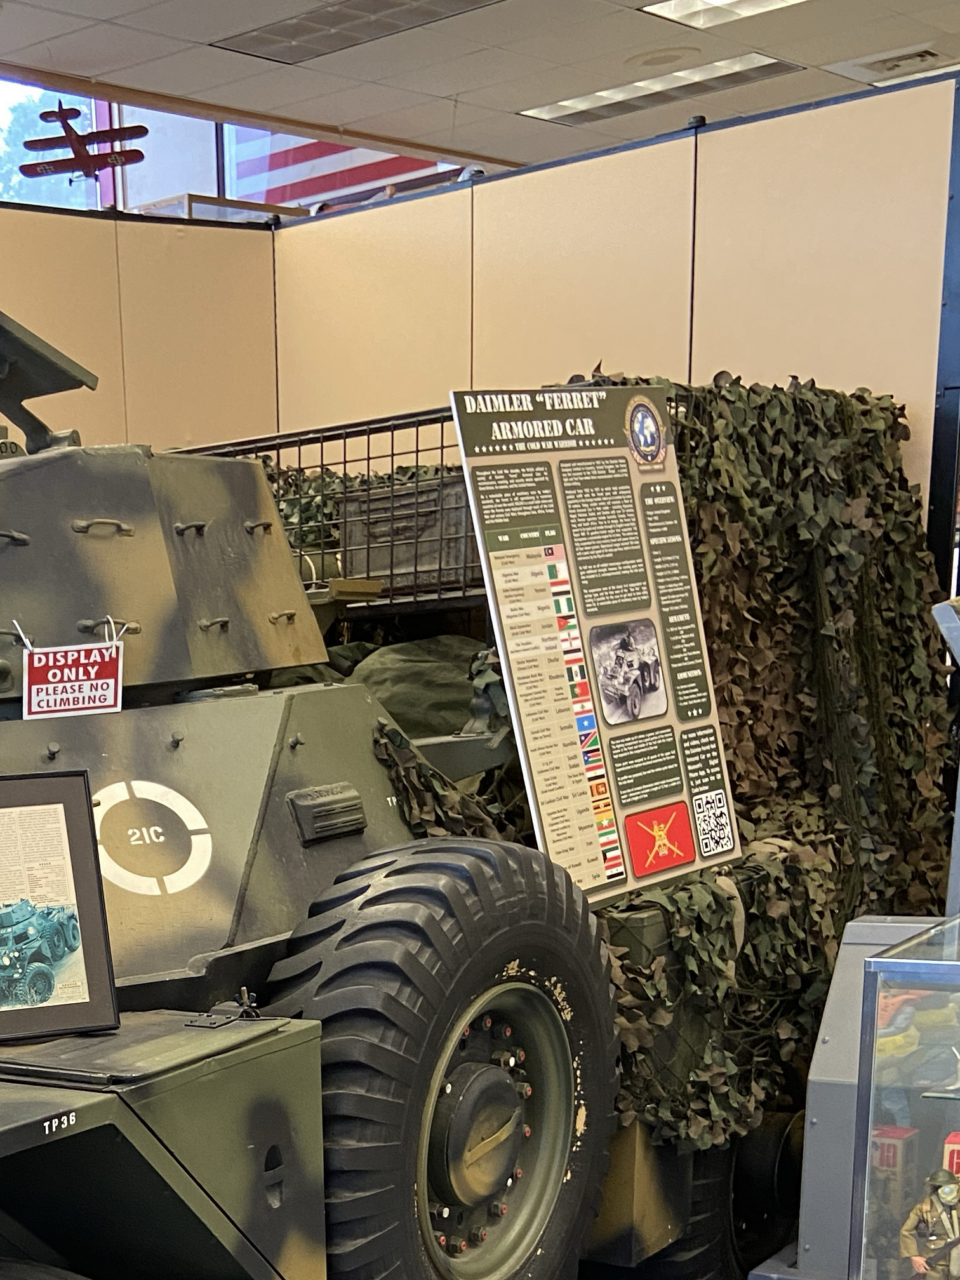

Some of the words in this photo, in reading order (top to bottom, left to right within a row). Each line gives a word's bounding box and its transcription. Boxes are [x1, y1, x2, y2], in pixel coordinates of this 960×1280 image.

[464, 394, 534, 413] DAIMLER
[491, 421, 563, 440] ARMORED
[565, 418, 596, 436] CAR
[515, 442, 526, 451] THE
[526, 441, 540, 450] COLD
[541, 440, 553, 449] WAR
[33, 648, 112, 668] DISPLAY
[47, 665, 99, 683] ONLY
[36, 684, 84, 697] PLEASE
[90, 682, 110, 692] NO
[37, 694, 107, 709] CLIMBING
